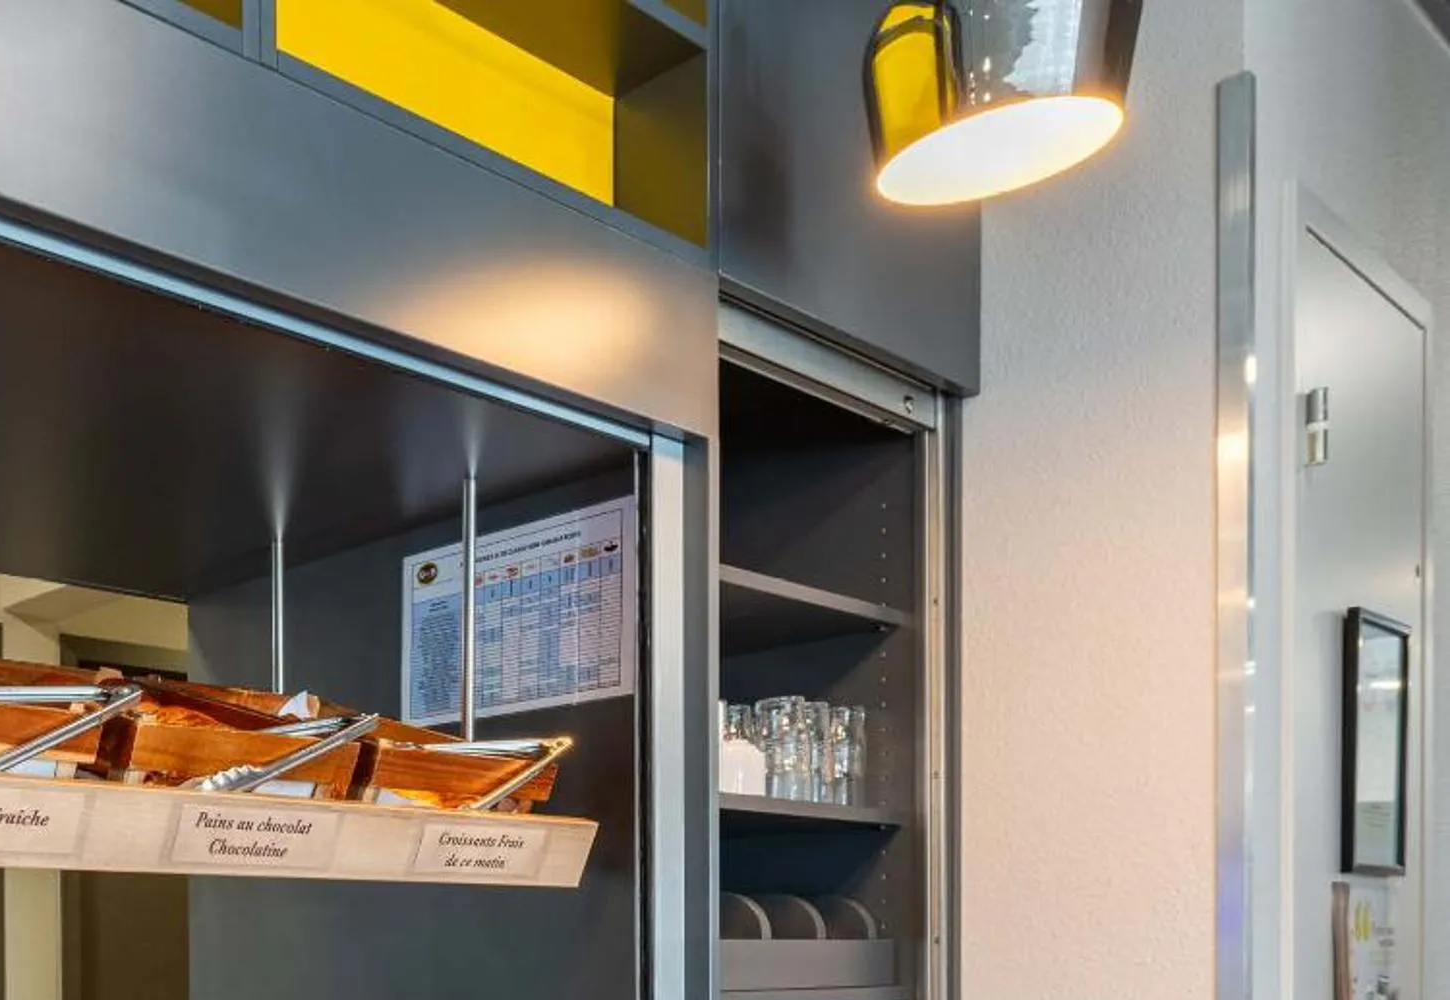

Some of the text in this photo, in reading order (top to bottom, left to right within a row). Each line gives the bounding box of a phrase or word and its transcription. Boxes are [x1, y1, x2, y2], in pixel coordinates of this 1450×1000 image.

[195, 811, 313, 835] Pains au chocolat
[208, 838, 288, 858] Chocolatine
[497, 834, 525, 849] Frais
[444, 853, 505, 869] de ce matin
